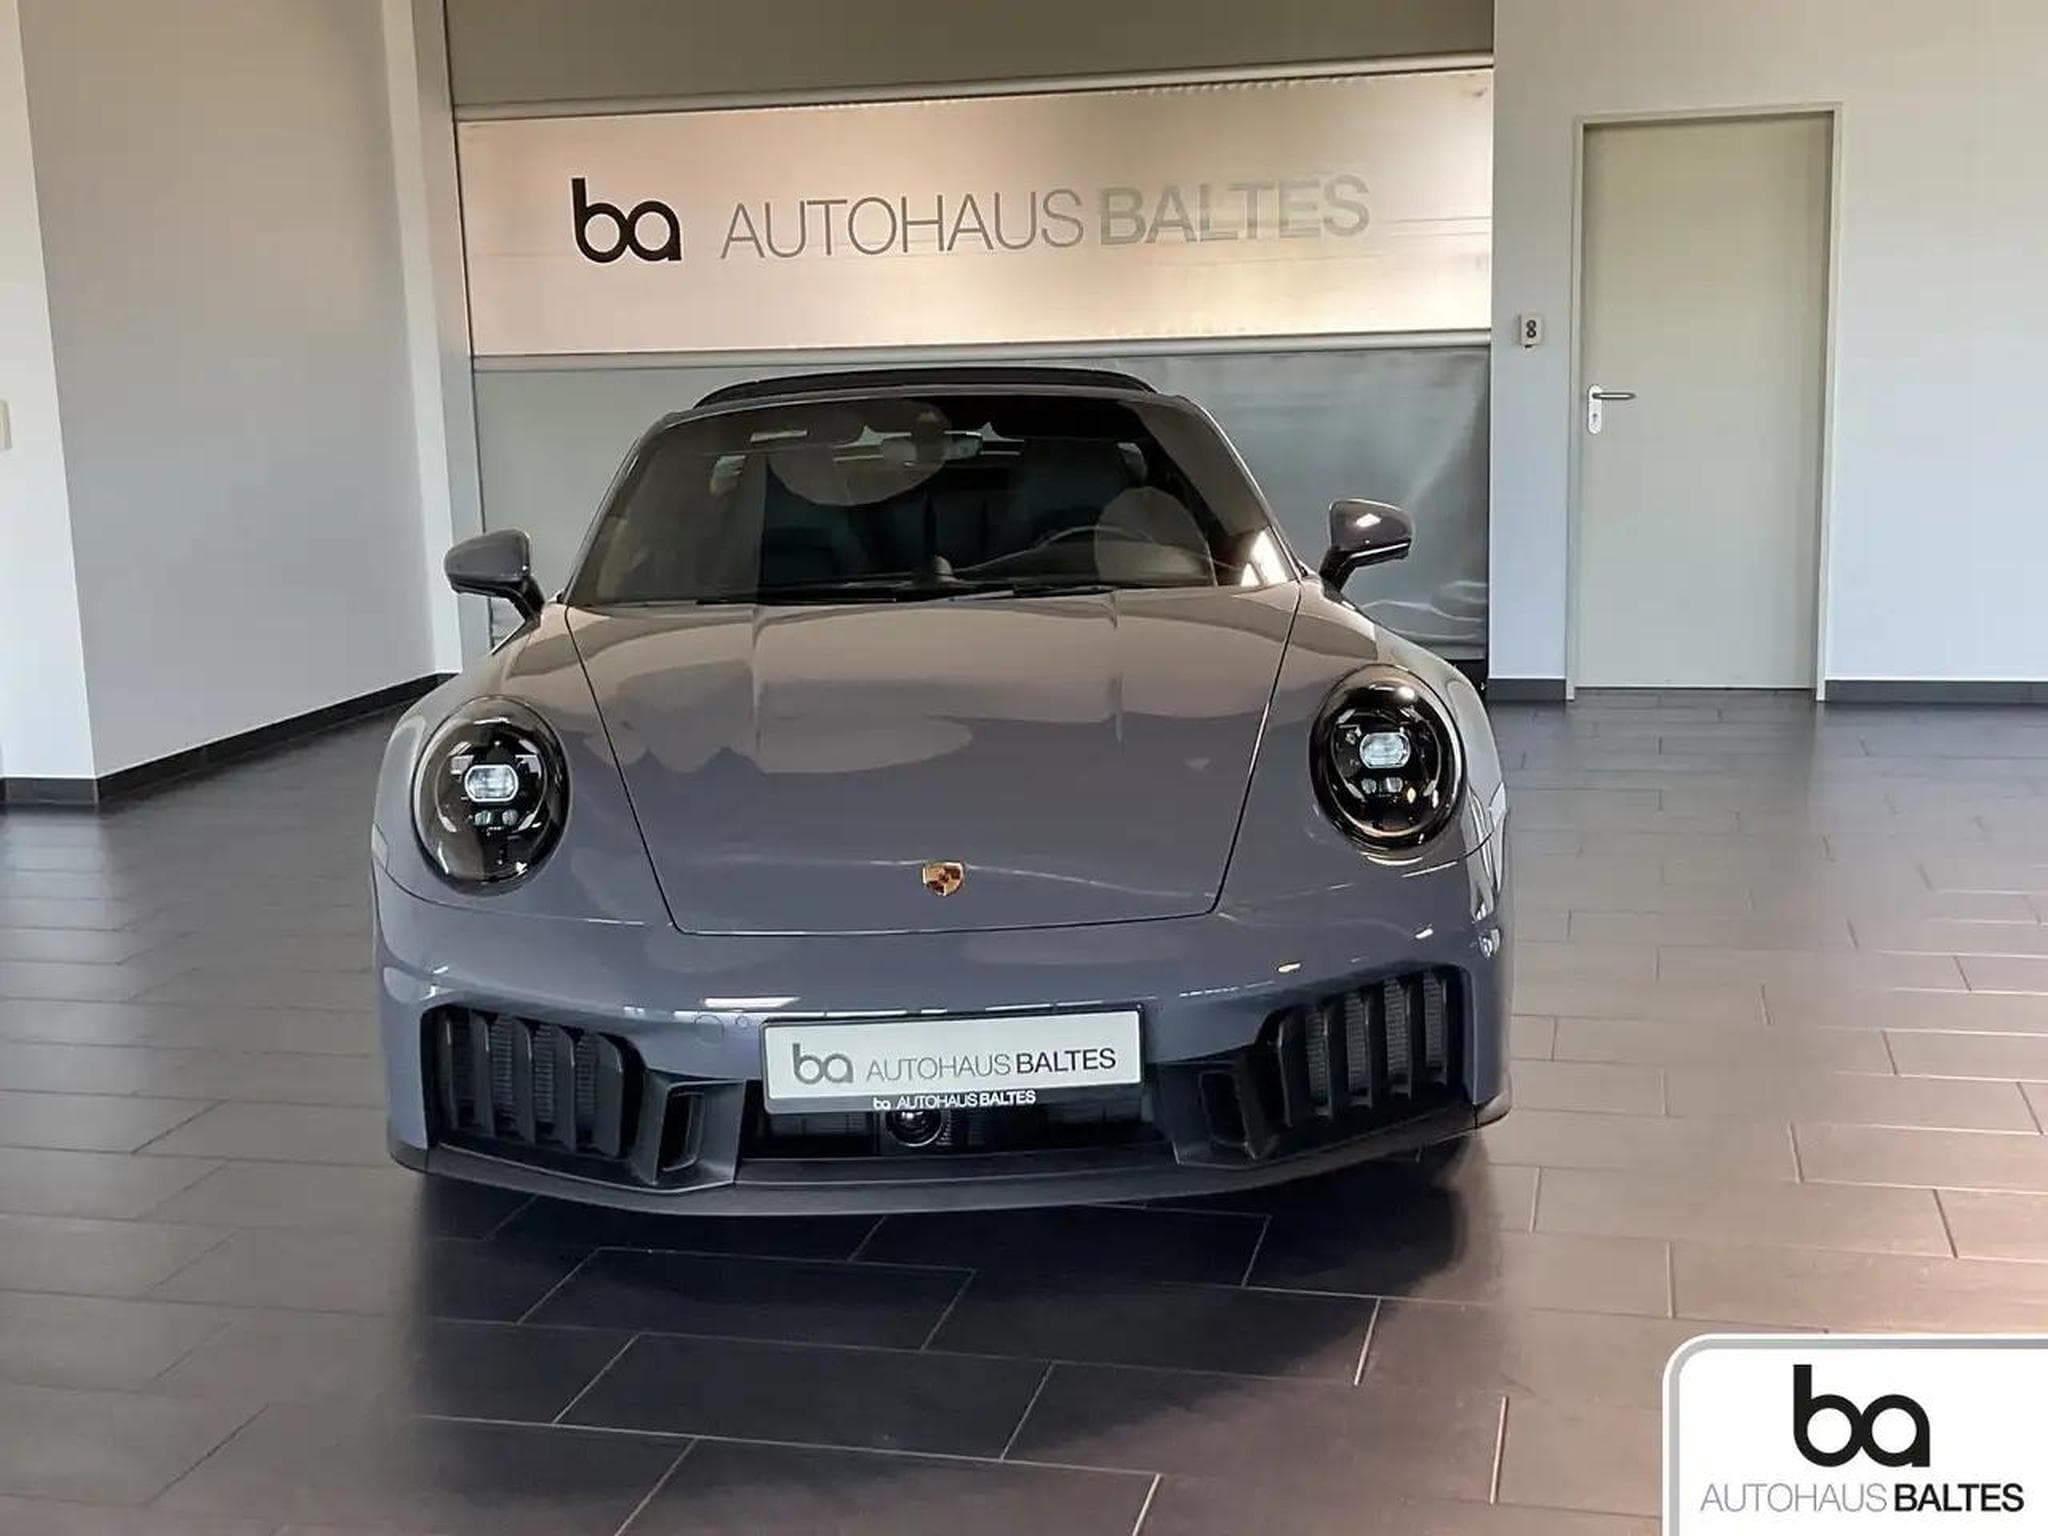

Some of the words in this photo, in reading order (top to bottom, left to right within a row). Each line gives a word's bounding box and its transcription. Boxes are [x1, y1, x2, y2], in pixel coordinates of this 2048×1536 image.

[572, 177, 682, 262] ba
[720, 188, 1085, 260] AUTOHAUS
[1096, 173, 1371, 247] BALTES
[792, 1043, 854, 1085] ba
[866, 1053, 1012, 1084] AUTOHAUS
[1016, 1047, 1117, 1075] BALTES
[873, 1097, 892, 1111] ba
[896, 1092, 978, 1111] AUTOHAUS
[979, 1089, 1037, 1108] BALTES
